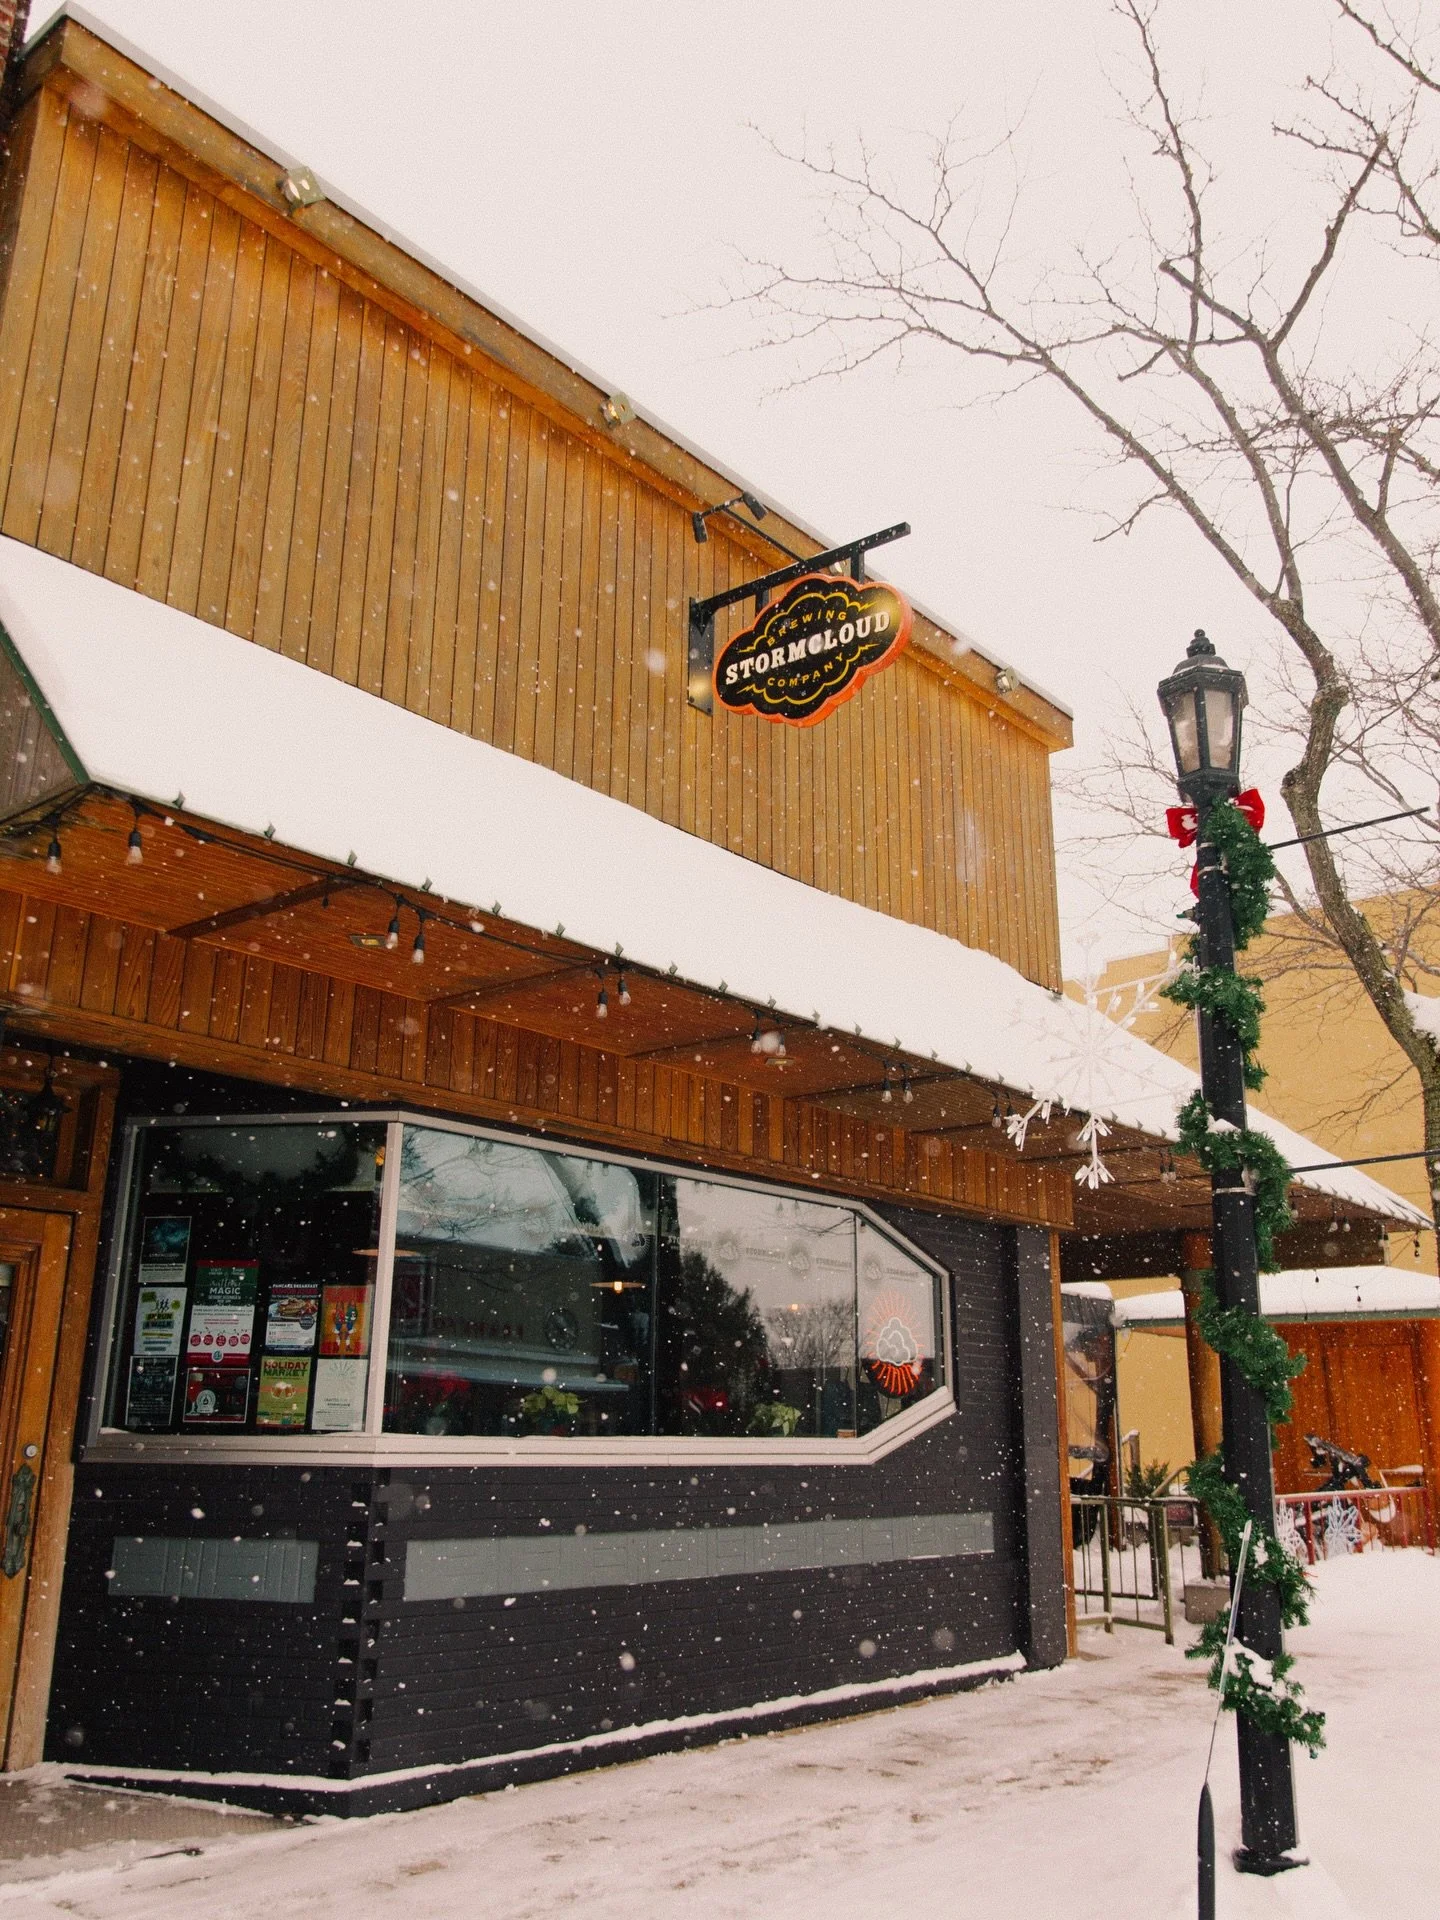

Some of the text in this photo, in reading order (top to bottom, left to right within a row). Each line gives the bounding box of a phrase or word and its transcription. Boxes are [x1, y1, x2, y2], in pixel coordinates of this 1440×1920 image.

[767, 610, 847, 646] BREWING
[725, 611, 891, 685] STORMCLOUD
[767, 652, 844, 687] COMPANY
[209, 1287, 241, 1295] MAGIC
[263, 1361, 309, 1369] HOLIDAY
[263, 1369, 308, 1377] MARKET
